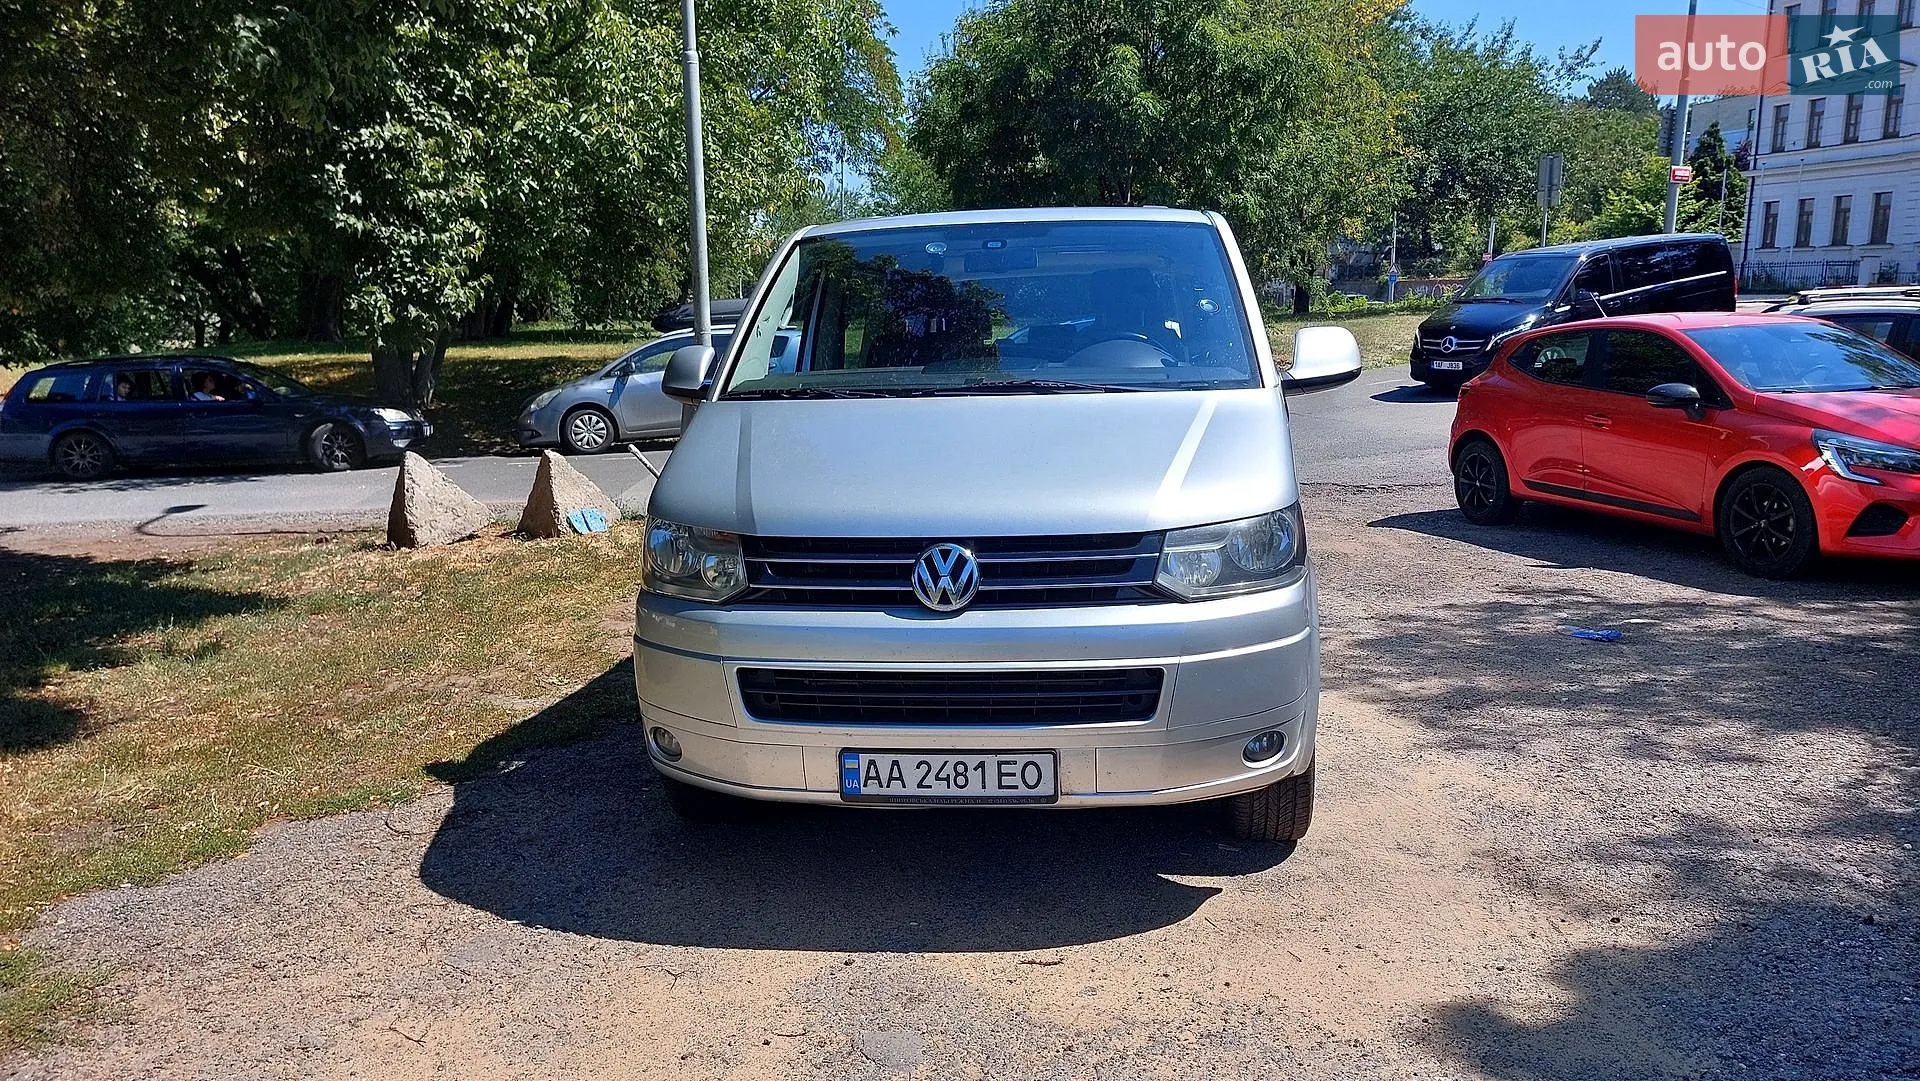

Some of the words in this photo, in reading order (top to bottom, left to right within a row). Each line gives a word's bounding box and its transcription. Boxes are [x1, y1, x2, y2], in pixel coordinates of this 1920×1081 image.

[845, 778, 860, 790] UA
[862, 758, 907, 789] AA
[914, 759, 987, 790] 2481
[996, 759, 1043, 790] EO
